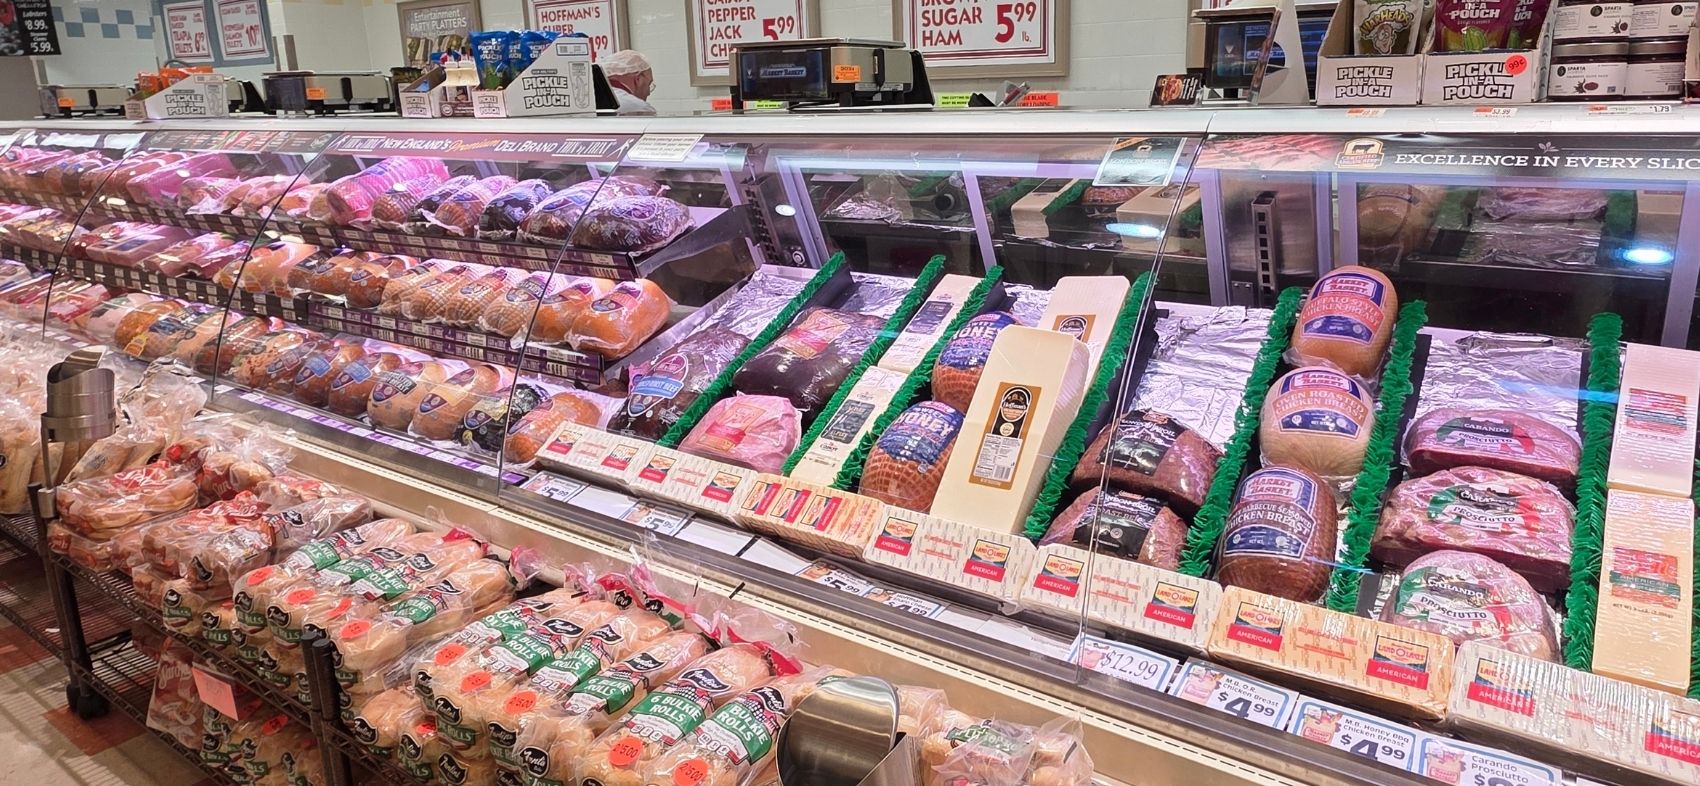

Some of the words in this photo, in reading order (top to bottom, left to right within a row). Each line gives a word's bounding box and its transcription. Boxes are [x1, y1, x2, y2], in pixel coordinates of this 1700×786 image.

[414, 9, 460, 22] Entertainment
[541, 6, 600, 22] HOFFMAN'S
[708, 6, 756, 23] PEPPER
[921, 6, 982, 27] SUGAR
[1360, 9, 1410, 32] WARHEADS
[1450, 9, 1500, 20] POUCH
[410, 22, 431, 31] PARTY
[432, 17, 467, 30] PLATTERS
[709, 25, 742, 40] JACK
[922, 30, 962, 46] HAM
[1337, 66, 1393, 80] PICKLE
[1446, 62, 1513, 79] PICKL
[522, 76, 568, 90] PICKLE
[1350, 78, 1377, 86] IN-A
[1461, 76, 1495, 85] IN-A
[165, 94, 204, 103] PICKLE
[1335, 85, 1392, 98] POUCH
[1443, 84, 1514, 100] POUCH
[525, 95, 570, 108] POUCH
[167, 106, 206, 115] POUCH
[381, 138, 400, 149] NEW
[400, 139, 451, 151] ENGLAND'S
[446, 139, 501, 152] Premium
[497, 140, 520, 152] DELI
[519, 141, 558, 152] BRAND
[1395, 154, 1527, 167] EXCELLENCE
[1533, 156, 1559, 167] IN
[1565, 156, 1642, 168] EVERY
[1327, 278, 1369, 287] MARKET
[1329, 284, 1368, 294] BASKET
[1302, 303, 1342, 318] CHICKEN
[1344, 305, 1379, 326] BREAST
[1306, 297, 1347, 311] BUFFALO
[1352, 298, 1380, 318] STYLE
[1301, 373, 1346, 382] MARKET
[1302, 379, 1346, 388] BASKET
[1276, 391, 1305, 408] OVEN
[1309, 390, 1364, 413] ROASTED
[1276, 398, 1322, 414] CHICKEN
[1325, 398, 1363, 420] BREAST
[894, 412, 954, 437] HONEY
[1464, 423, 1509, 433] CARANDO
[1459, 433, 1512, 443] PROSCIUTTO
[1252, 478, 1294, 487] MARKET
[1250, 486, 1293, 495] BASKET
[1278, 506, 1312, 528] SEASONED
[1454, 506, 1516, 522] PROSCIUTTO
[1228, 511, 1264, 530] CHICKEN
[1267, 511, 1309, 534] BREAST
[881, 541, 905, 550] AMERICAN
[971, 565, 997, 577] AMERICAN
[370, 573, 390, 590] OLLS
[1041, 580, 1070, 591] AMERICAN
[1426, 577, 1484, 599] CARANDO
[1157, 590, 1171, 598] LAND
[1420, 596, 1487, 619] PROSCIUTTO
[1153, 610, 1186, 622] AMERICAN
[1236, 630, 1272, 645] AMERICAN
[507, 639, 536, 660] ROLLS
[520, 633, 549, 659] BULKIE
[1378, 645, 1395, 654] LAND
[1406, 651, 1424, 660] LAKES
[1101, 649, 1158, 680] $12.99
[1377, 667, 1418, 682] AMERICAN
[586, 684, 615, 695] ROLLS
[600, 679, 630, 695] BULKIE
[1225, 678, 1241, 688] M.B.
[1223, 682, 1252, 697] Chicken
[1254, 693, 1279, 707] Breast
[1478, 690, 1524, 708] AMERICAN
[650, 705, 684, 722] ROLLS
[651, 696, 658, 704] 6
[664, 697, 701, 721] BULKIE
[718, 713, 750, 741] ROLLS
[730, 706, 769, 744] BULKIE
[1345, 718, 1363, 729] M.B.
[1364, 723, 1391, 737] Honey
[1343, 724, 1376, 740] Chicken
[1376, 735, 1405, 748] Breast
[1471, 755, 1518, 772] Carando
[1471, 763, 1529, 784] Prosciutto
